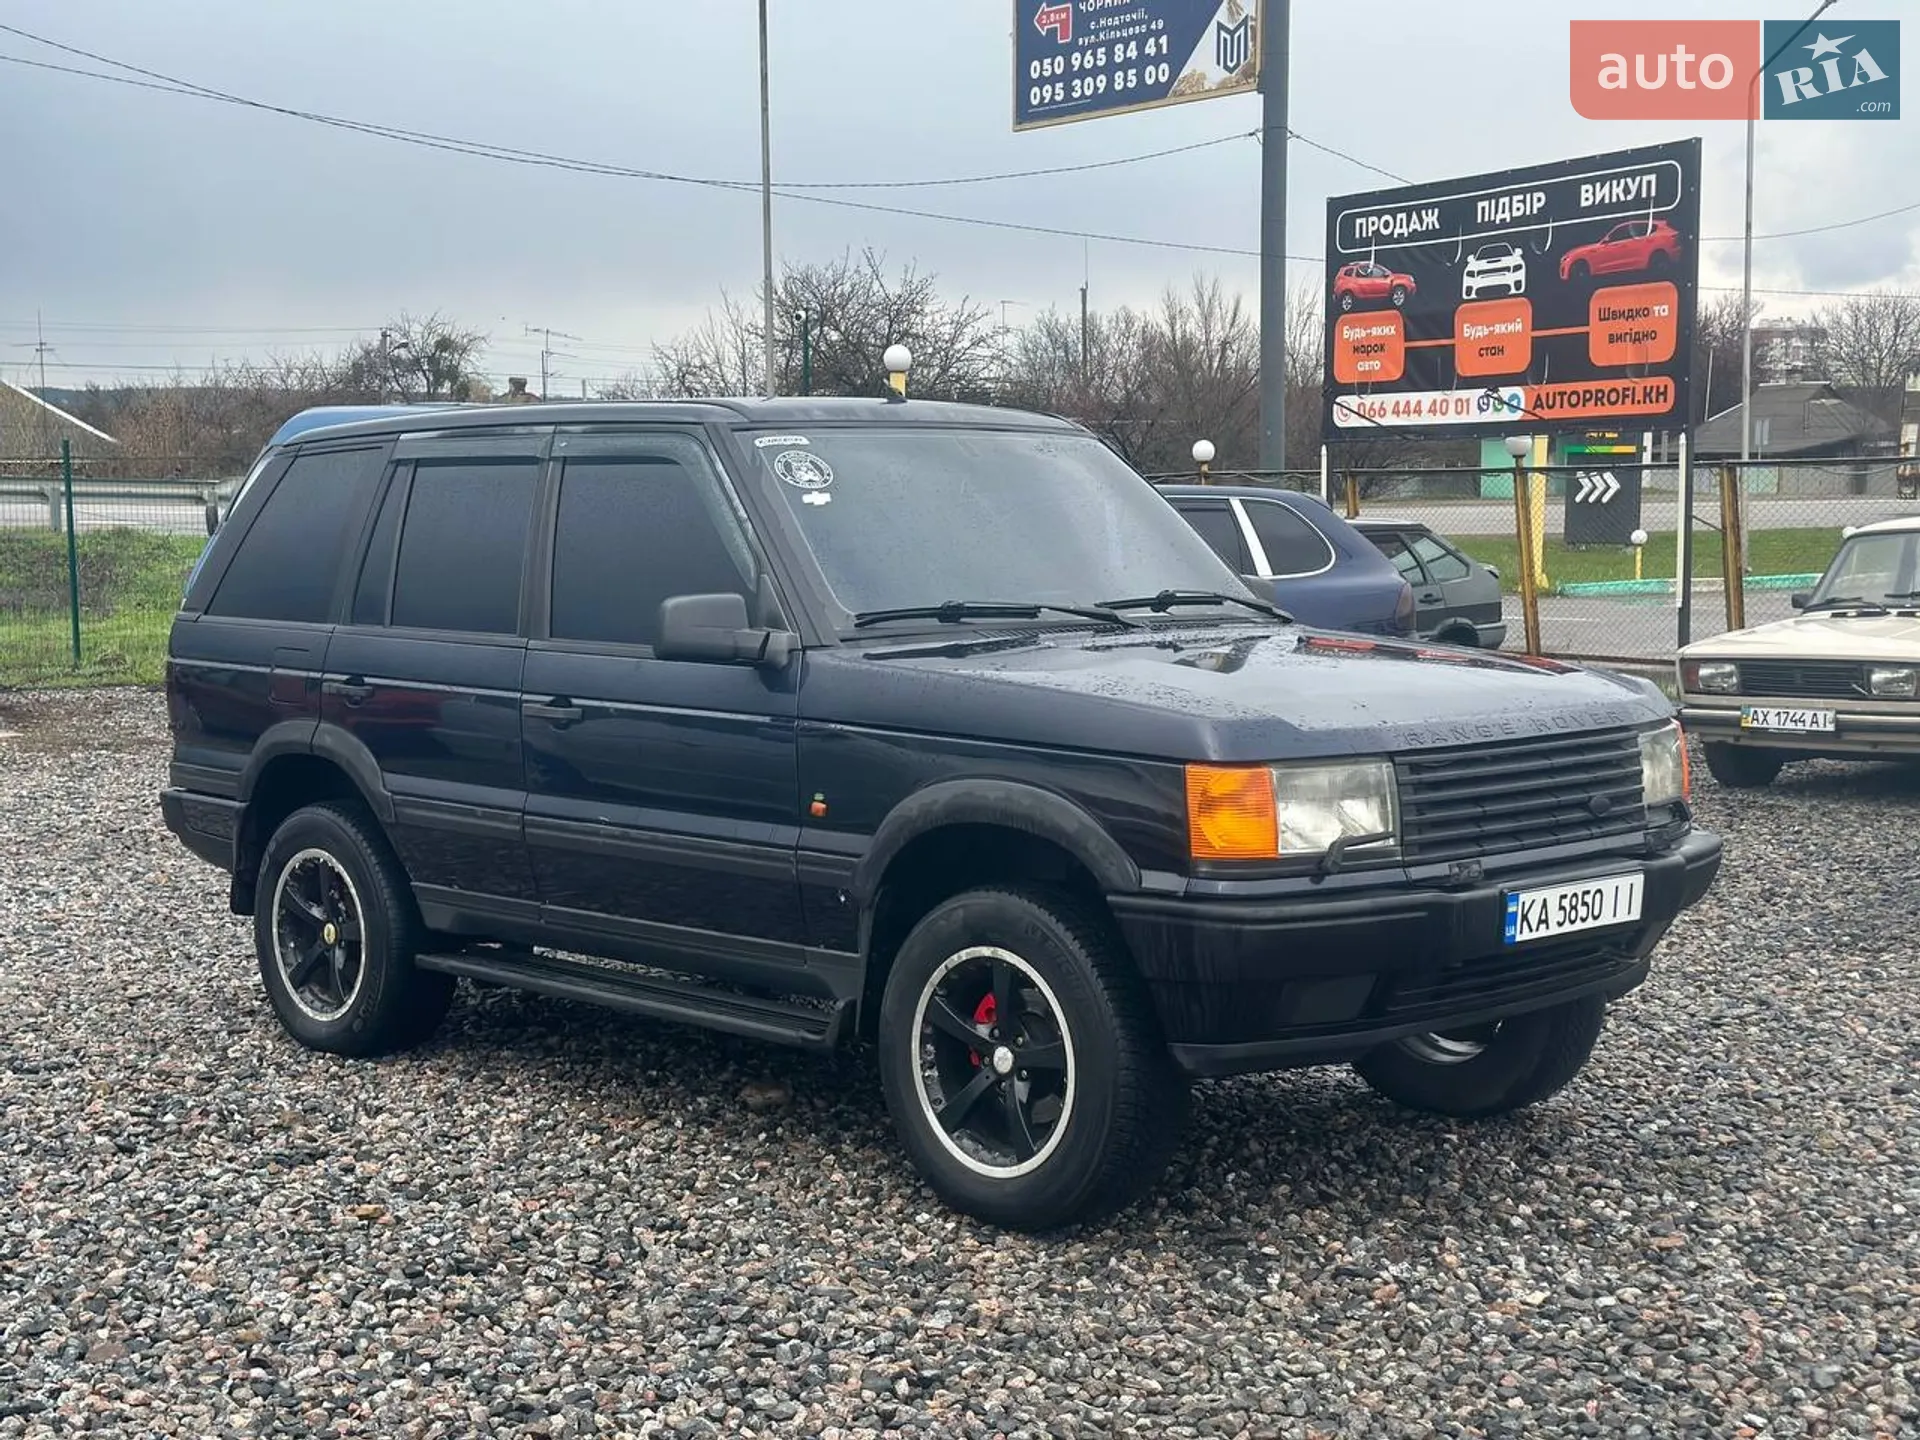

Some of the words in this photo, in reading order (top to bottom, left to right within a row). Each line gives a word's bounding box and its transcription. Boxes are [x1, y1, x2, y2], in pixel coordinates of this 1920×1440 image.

[1150, 19, 1164, 31] 49
[1030, 55, 1065, 79] 050
[1071, 46, 1107, 71] 965
[1114, 40, 1138, 63] 84
[1144, 34, 1168, 57] 41
[1030, 82, 1065, 105] 095
[1071, 74, 1107, 98] 309
[1114, 68, 1137, 91] 85
[1144, 62, 1170, 85] 00
[1354, 207, 1440, 239] ПРОДАЖ
[1476, 191, 1546, 224] ПІДБІР
[1579, 173, 1657, 209] ВИКУП
[1598, 305, 1650, 322] Швидко
[1653, 304, 1669, 317] та
[1343, 325, 1396, 341] Будь-яких
[1463, 318, 1522, 340] Будь-який
[1607, 329, 1657, 347] вигідно
[1478, 344, 1504, 357] стан
[1357, 360, 1381, 372] авто
[1357, 401, 1387, 418] 066
[1391, 400, 1422, 417] 444
[1428, 398, 1449, 416] 40
[1454, 397, 1471, 415] 01
[1532, 384, 1668, 411] AUTOPROFI.KH
[1750, 709, 1770, 726] AX
[1775, 711, 1806, 728] 1744
[1519, 898, 1550, 935] KA
[1556, 888, 1604, 927] 5850
